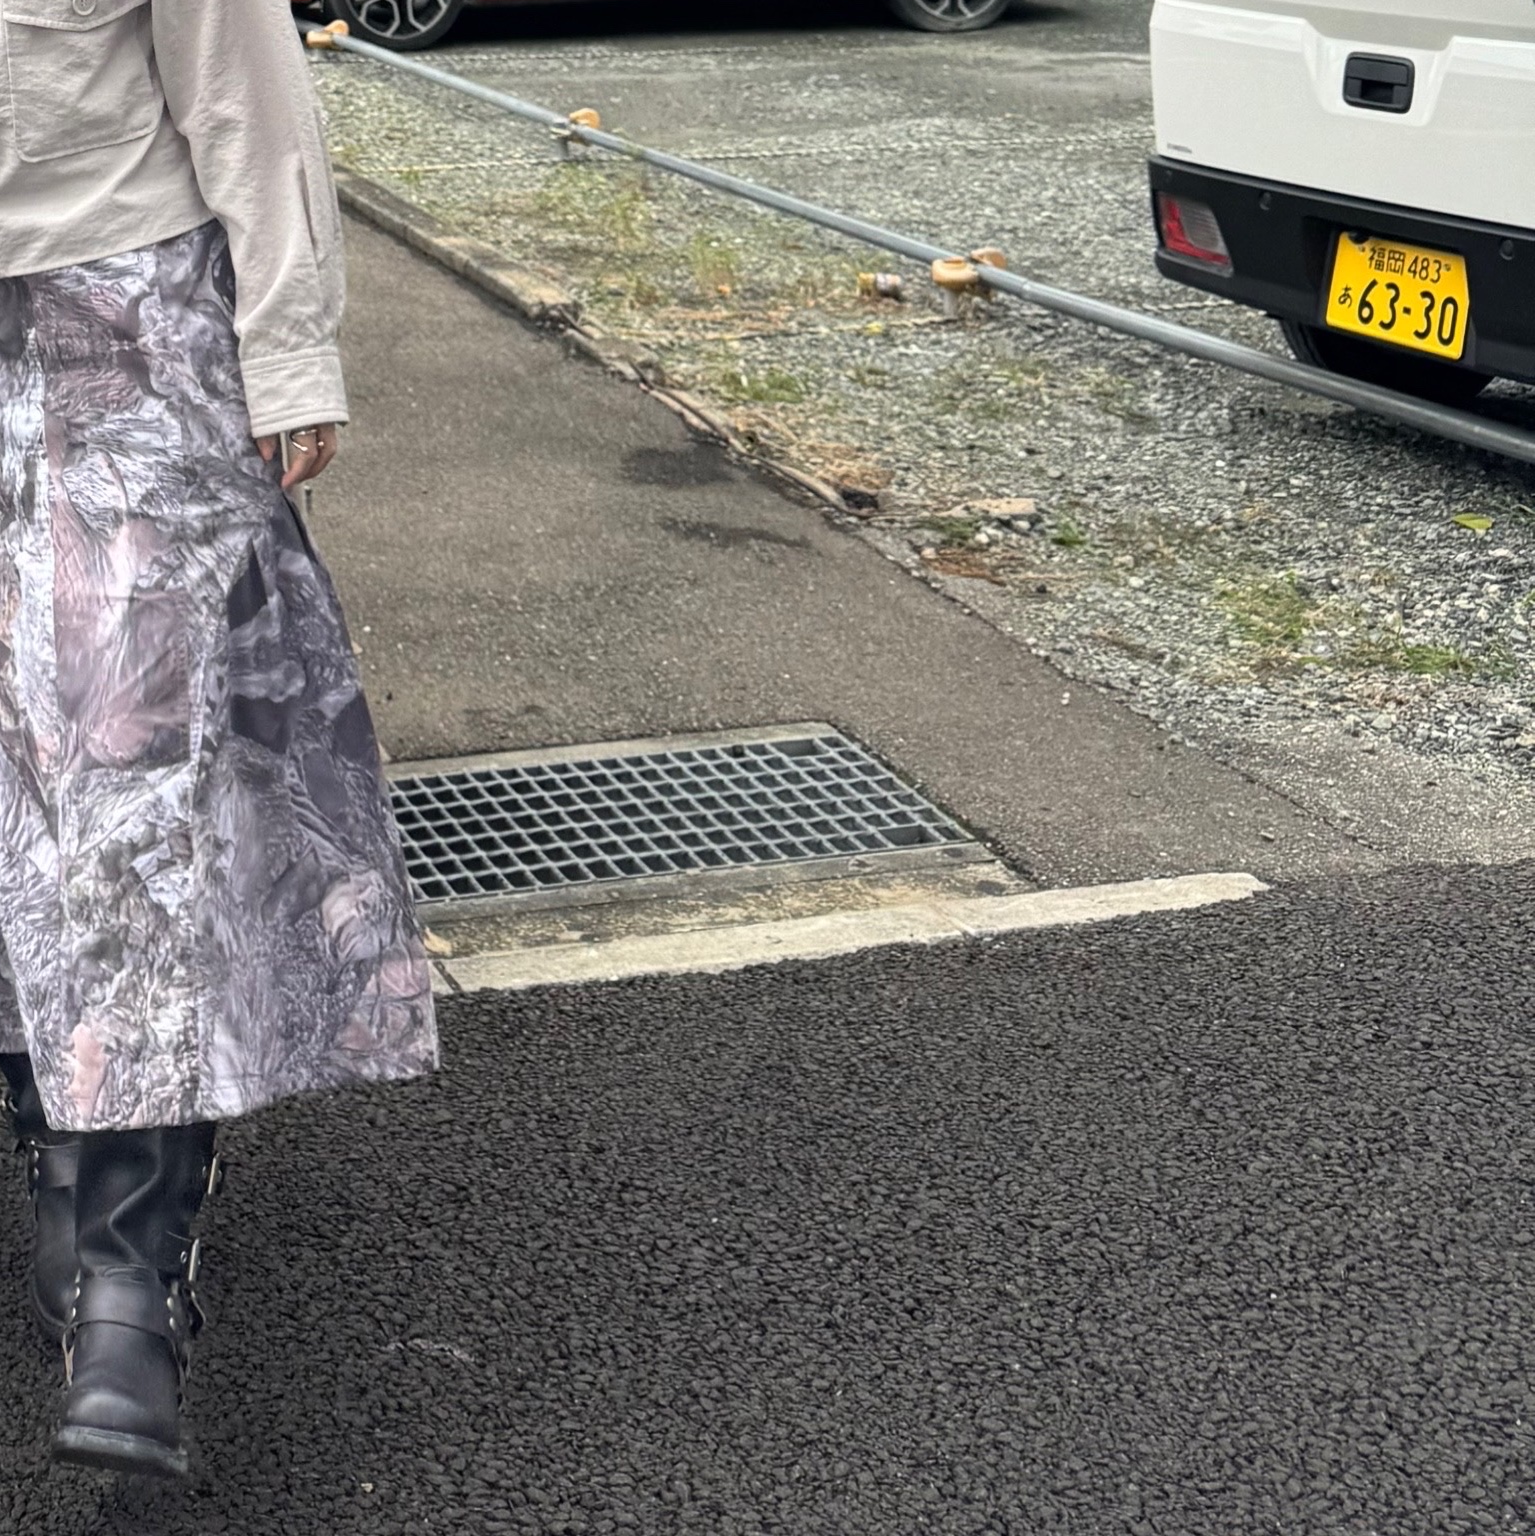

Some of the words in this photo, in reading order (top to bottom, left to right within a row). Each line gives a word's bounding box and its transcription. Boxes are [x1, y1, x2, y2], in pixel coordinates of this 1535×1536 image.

[1368, 246, 1406, 276] 福岡
[1408, 255, 1443, 284] 483
[1338, 284, 1353, 309] あ
[1357, 278, 1459, 347] 63-30
